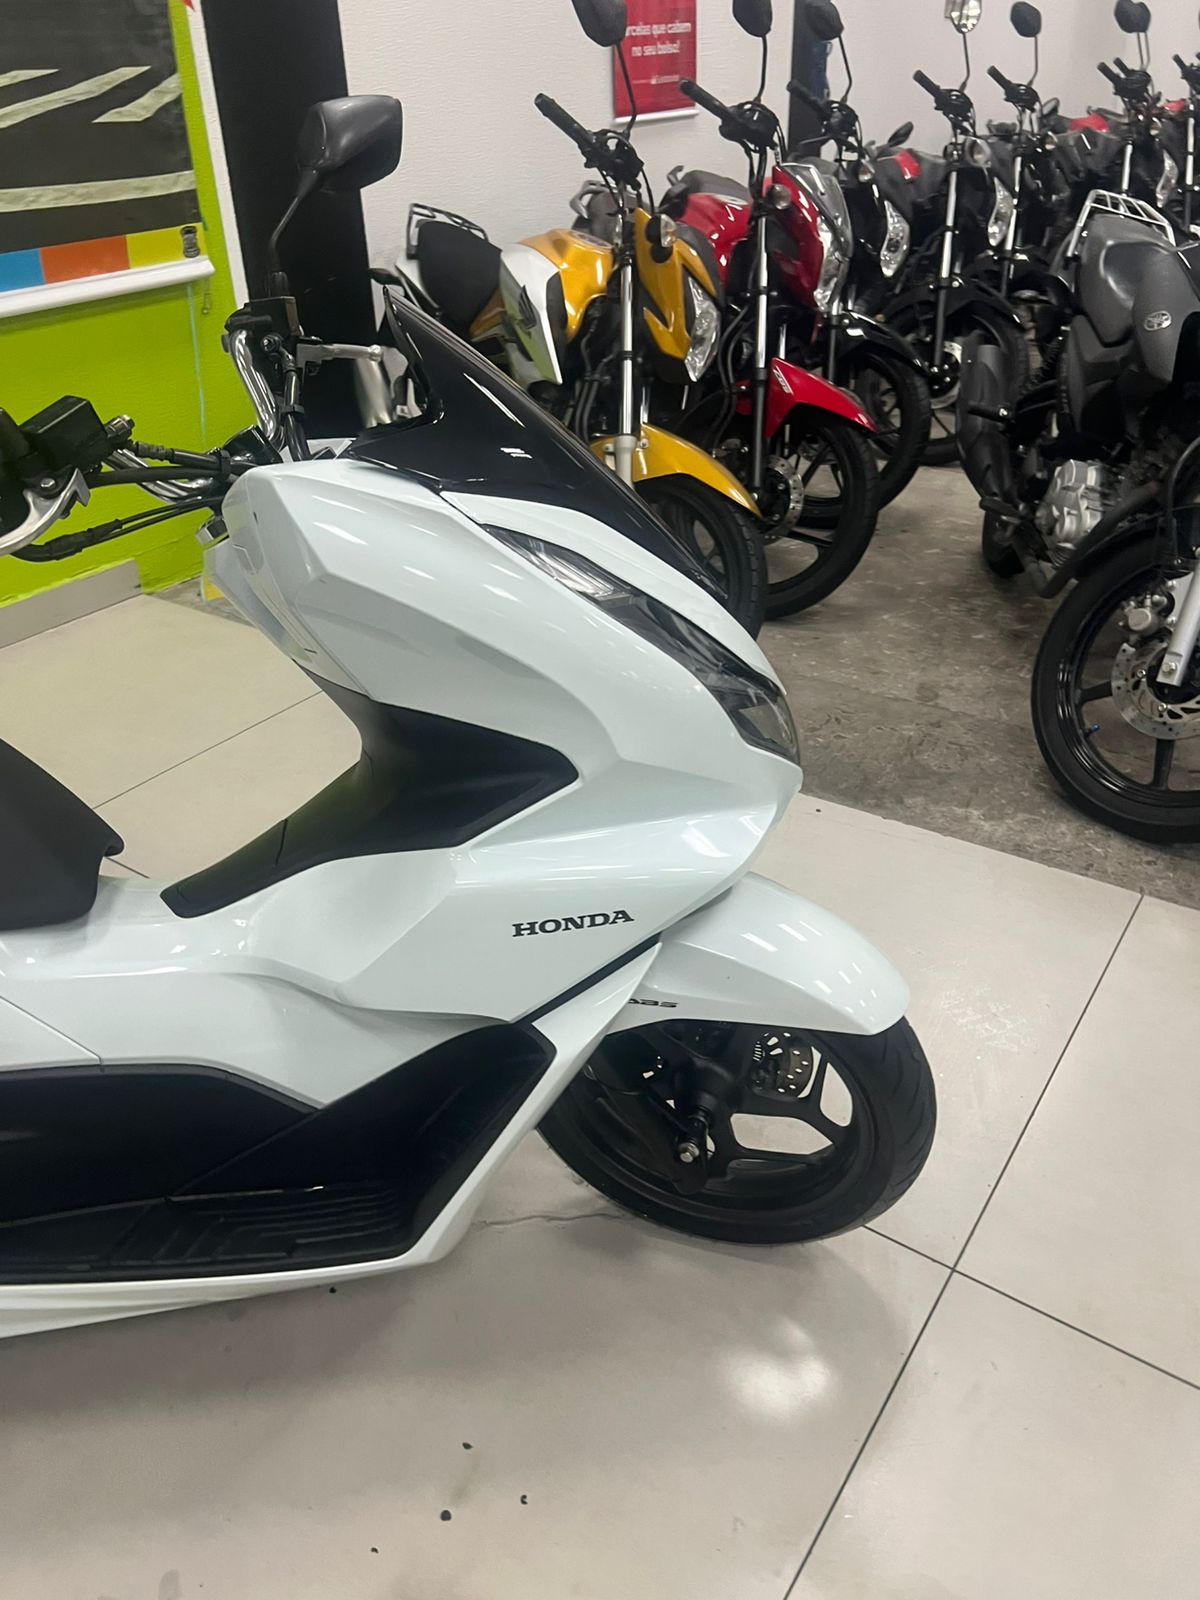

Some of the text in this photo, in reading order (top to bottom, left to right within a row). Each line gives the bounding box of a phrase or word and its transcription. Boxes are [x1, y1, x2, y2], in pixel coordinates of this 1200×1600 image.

[625, 22, 651, 37] rcelas
[631, 46, 642, 57] no
[512, 909, 635, 938] HONDA
